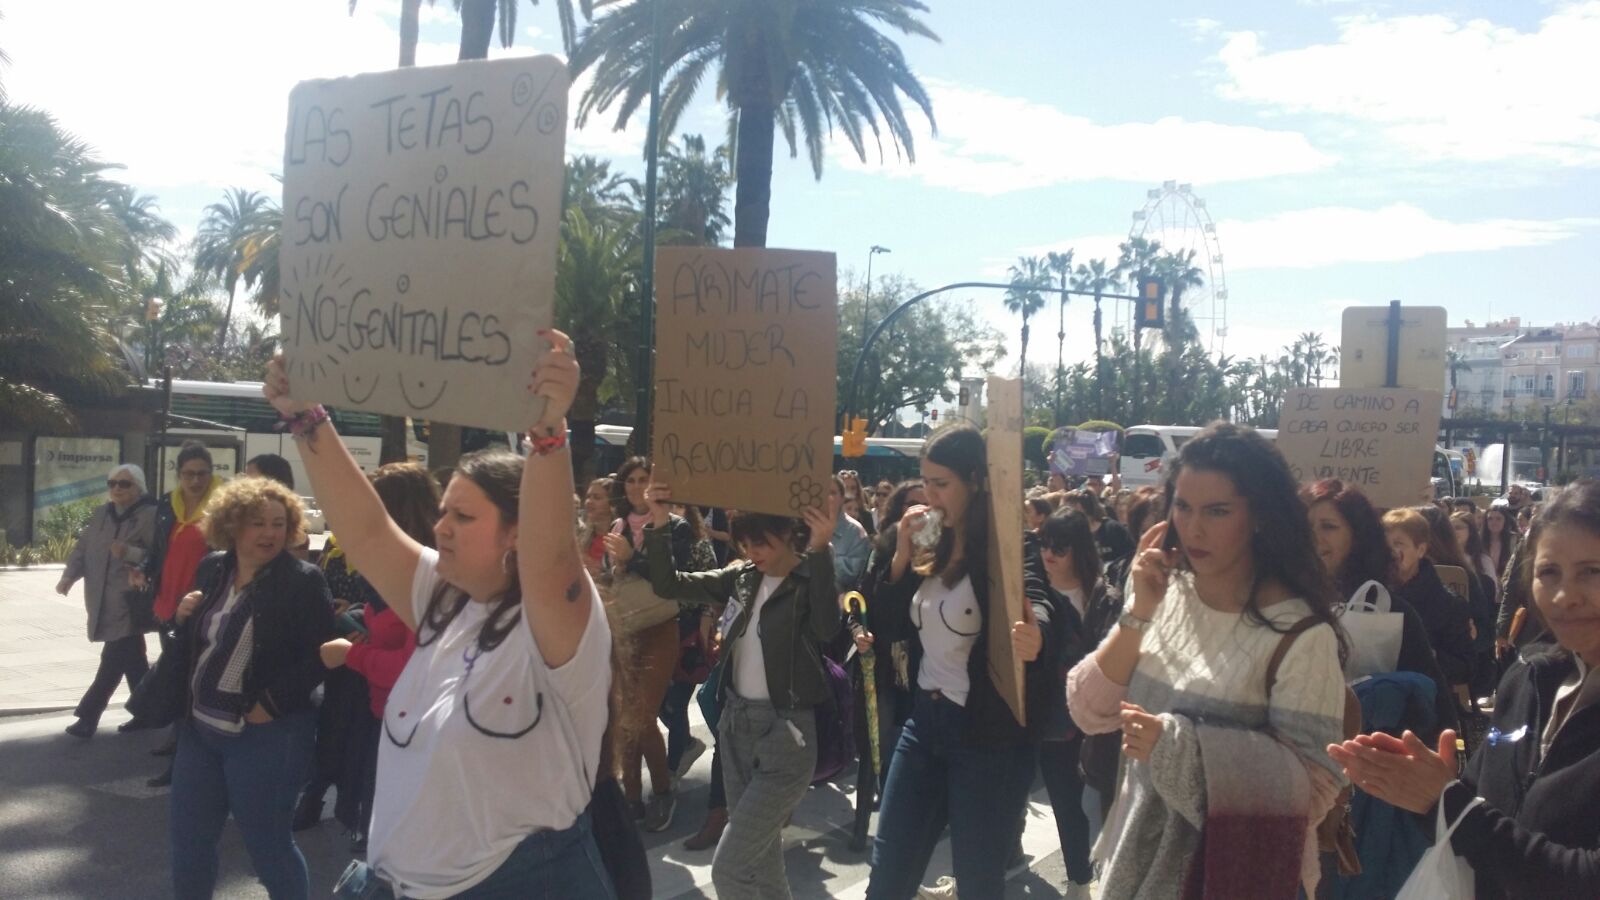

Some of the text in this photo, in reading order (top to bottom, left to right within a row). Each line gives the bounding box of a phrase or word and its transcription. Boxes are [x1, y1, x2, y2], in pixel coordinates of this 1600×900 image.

[289, 86, 494, 167] LAS TETAS
[295, 166, 540, 245] SON GENIALES
[686, 323, 796, 370] MUJER
[658, 378, 809, 419] INICIA LA
[1296, 393, 1420, 414] DE CAMINO A
[1287, 420, 1420, 434] CASA QUIERO SER
[1320, 438, 1379, 458] LIBRE
[662, 427, 822, 476] REVOLUCIÓN
